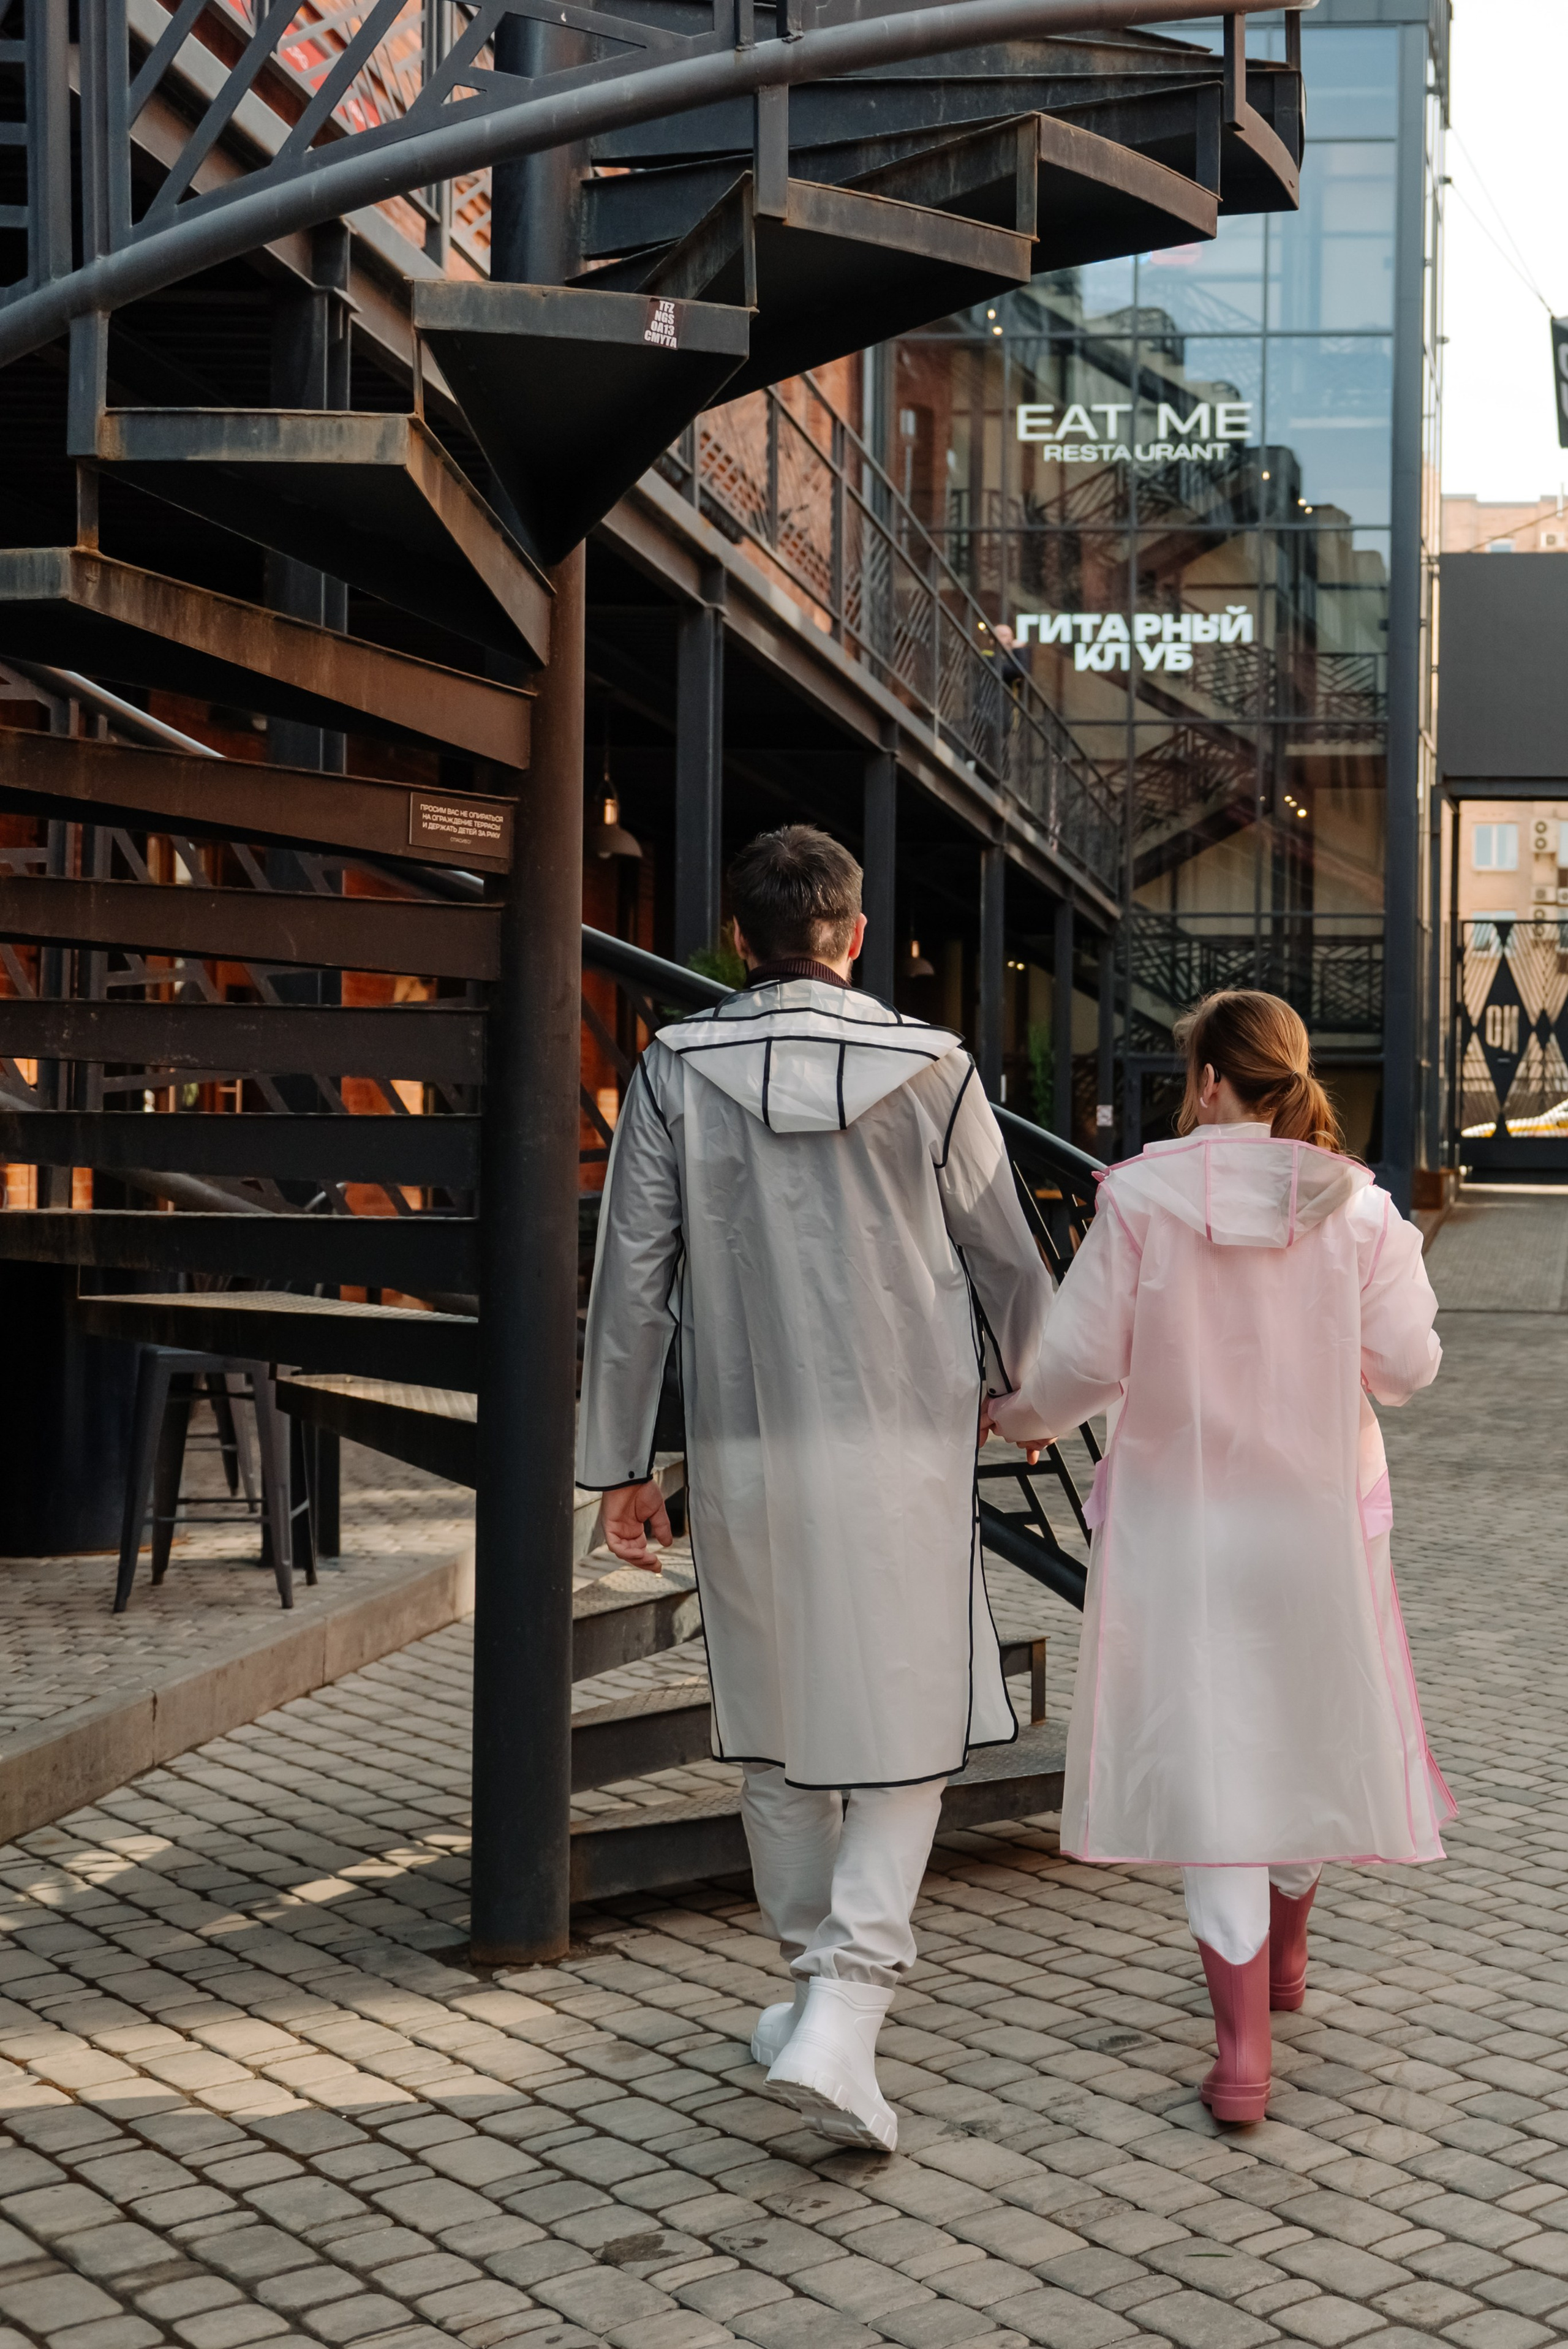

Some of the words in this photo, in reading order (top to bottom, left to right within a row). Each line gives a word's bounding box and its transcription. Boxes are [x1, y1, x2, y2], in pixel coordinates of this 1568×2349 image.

[659, 300, 675, 314] TFZ
[654, 310, 674, 325] NGS
[1016, 403, 1133, 441] EAT
[1158, 402, 1253, 439] ME
[1043, 442, 1230, 462] RESTAURANT
[1016, 605, 1253, 643] ГИТАРНЫЙ
[1074, 642, 1194, 671] КЛУБ
[420, 804, 447, 814] ПРОСИМ
[447, 808, 459, 816] ВАС
[469, 812, 503, 823] ОПИРАТЬСЯ
[432, 814, 473, 827] ОГРАЖДЕНИЕ
[473, 820, 501, 831] ТЕРРАСЫ
[428, 823, 458, 833] ДЕРЖАТЬ
[458, 826, 477, 835] ДЕТЕЙ
